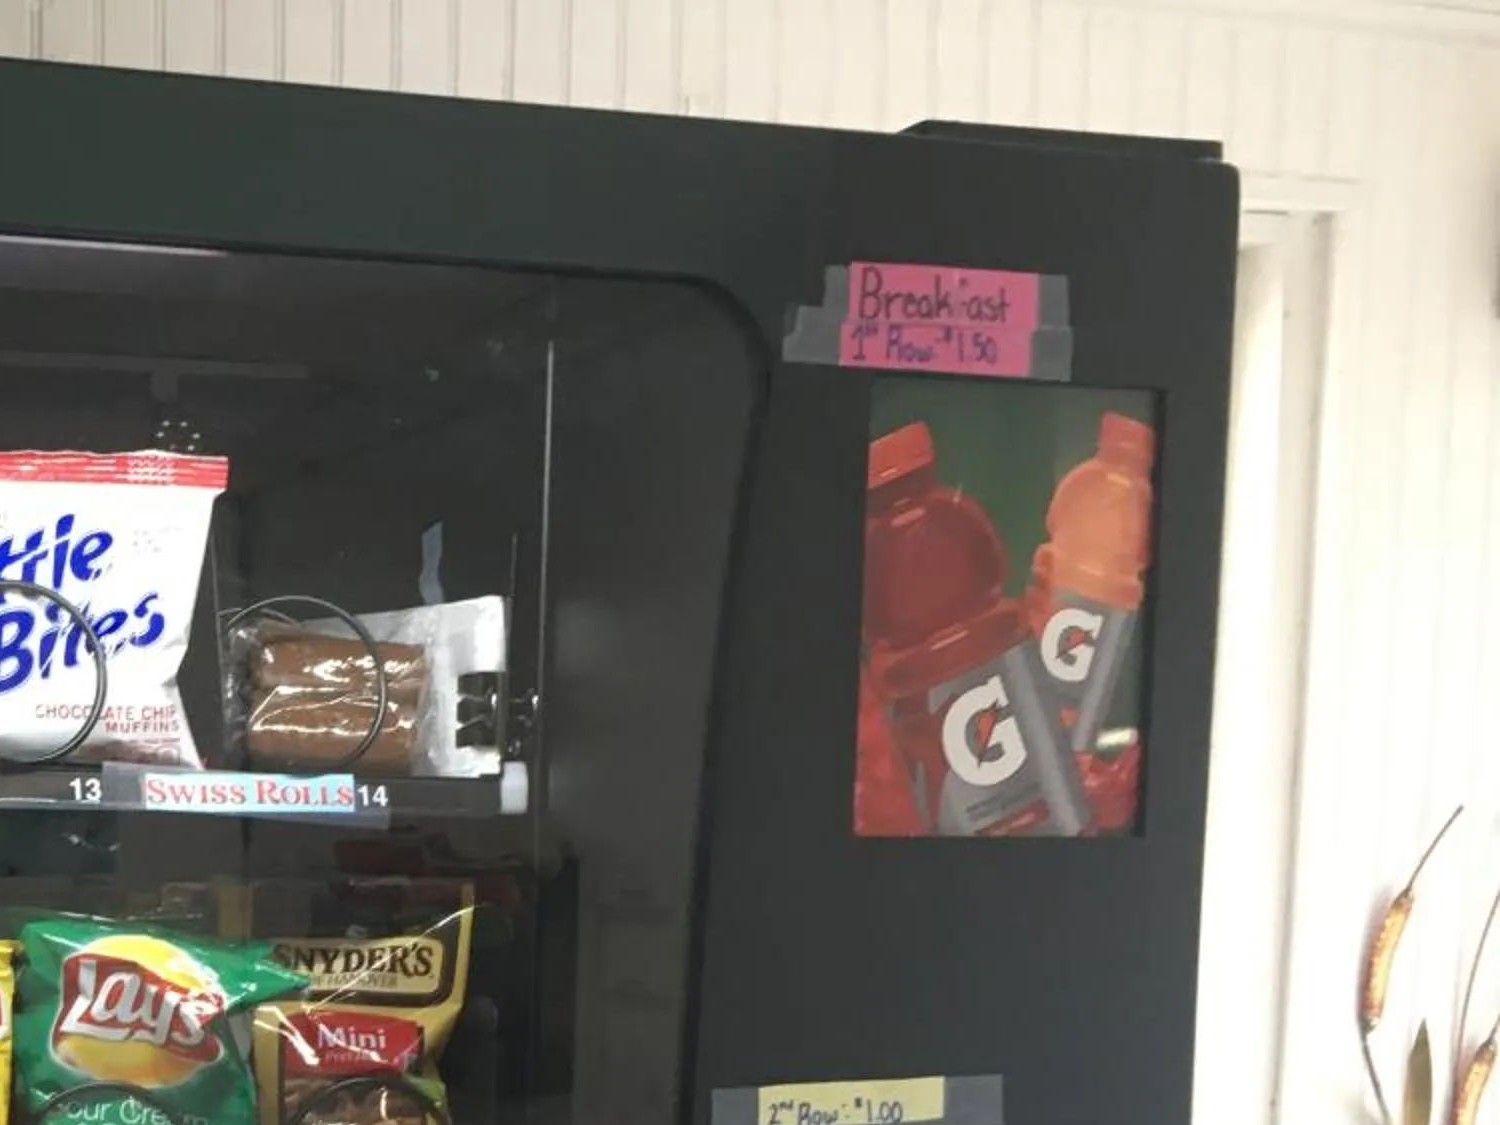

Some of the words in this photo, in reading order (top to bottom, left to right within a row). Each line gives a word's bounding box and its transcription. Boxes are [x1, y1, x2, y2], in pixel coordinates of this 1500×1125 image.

[1041, 607, 1104, 682] G
[35, 703, 135, 721] CHOCOATE
[141, 704, 177, 721] CHIP
[104, 720, 181, 734] MUFFINS
[942, 675, 1028, 787] G
[68, 777, 103, 802] 13
[358, 784, 389, 807] 14
[273, 943, 433, 978] SNYDER'S
[317, 1024, 387, 1050] Mini
[57, 1101, 111, 1121] our
